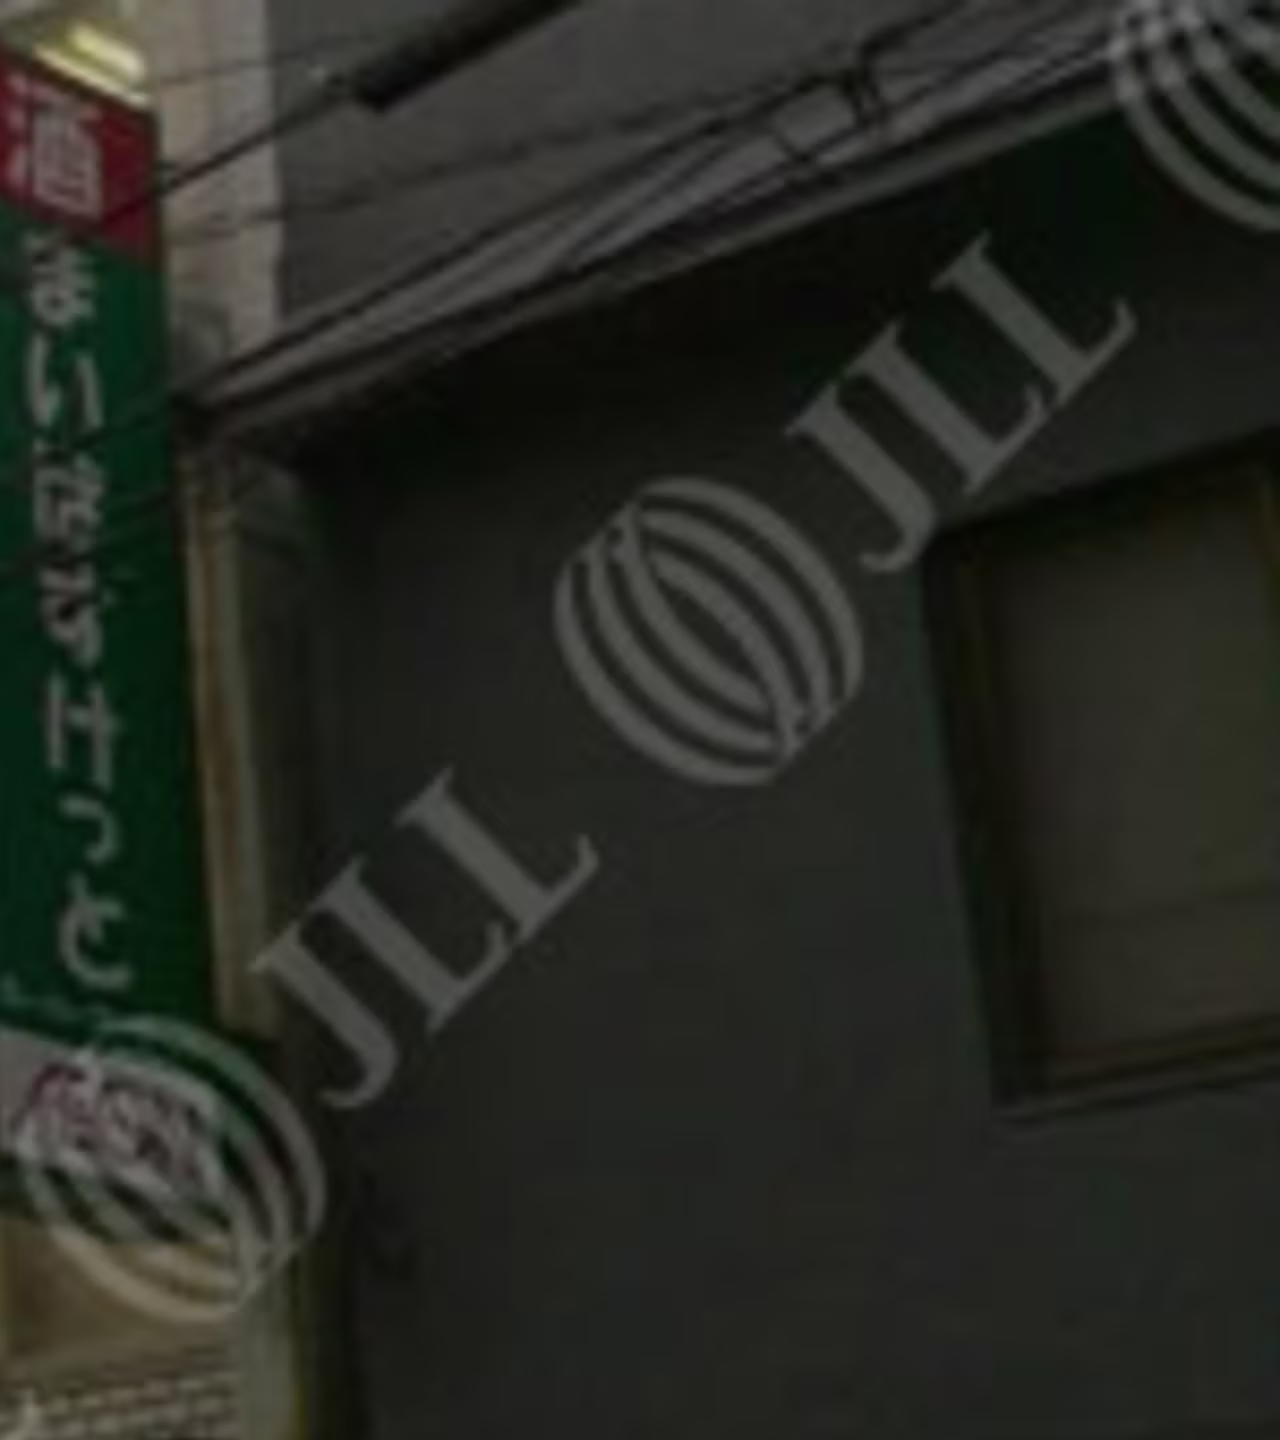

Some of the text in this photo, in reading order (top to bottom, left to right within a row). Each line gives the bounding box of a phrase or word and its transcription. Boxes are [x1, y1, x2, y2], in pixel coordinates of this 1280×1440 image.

[4, 64, 106, 224] 酒
[26, 228, 136, 994] まいばすけっと
